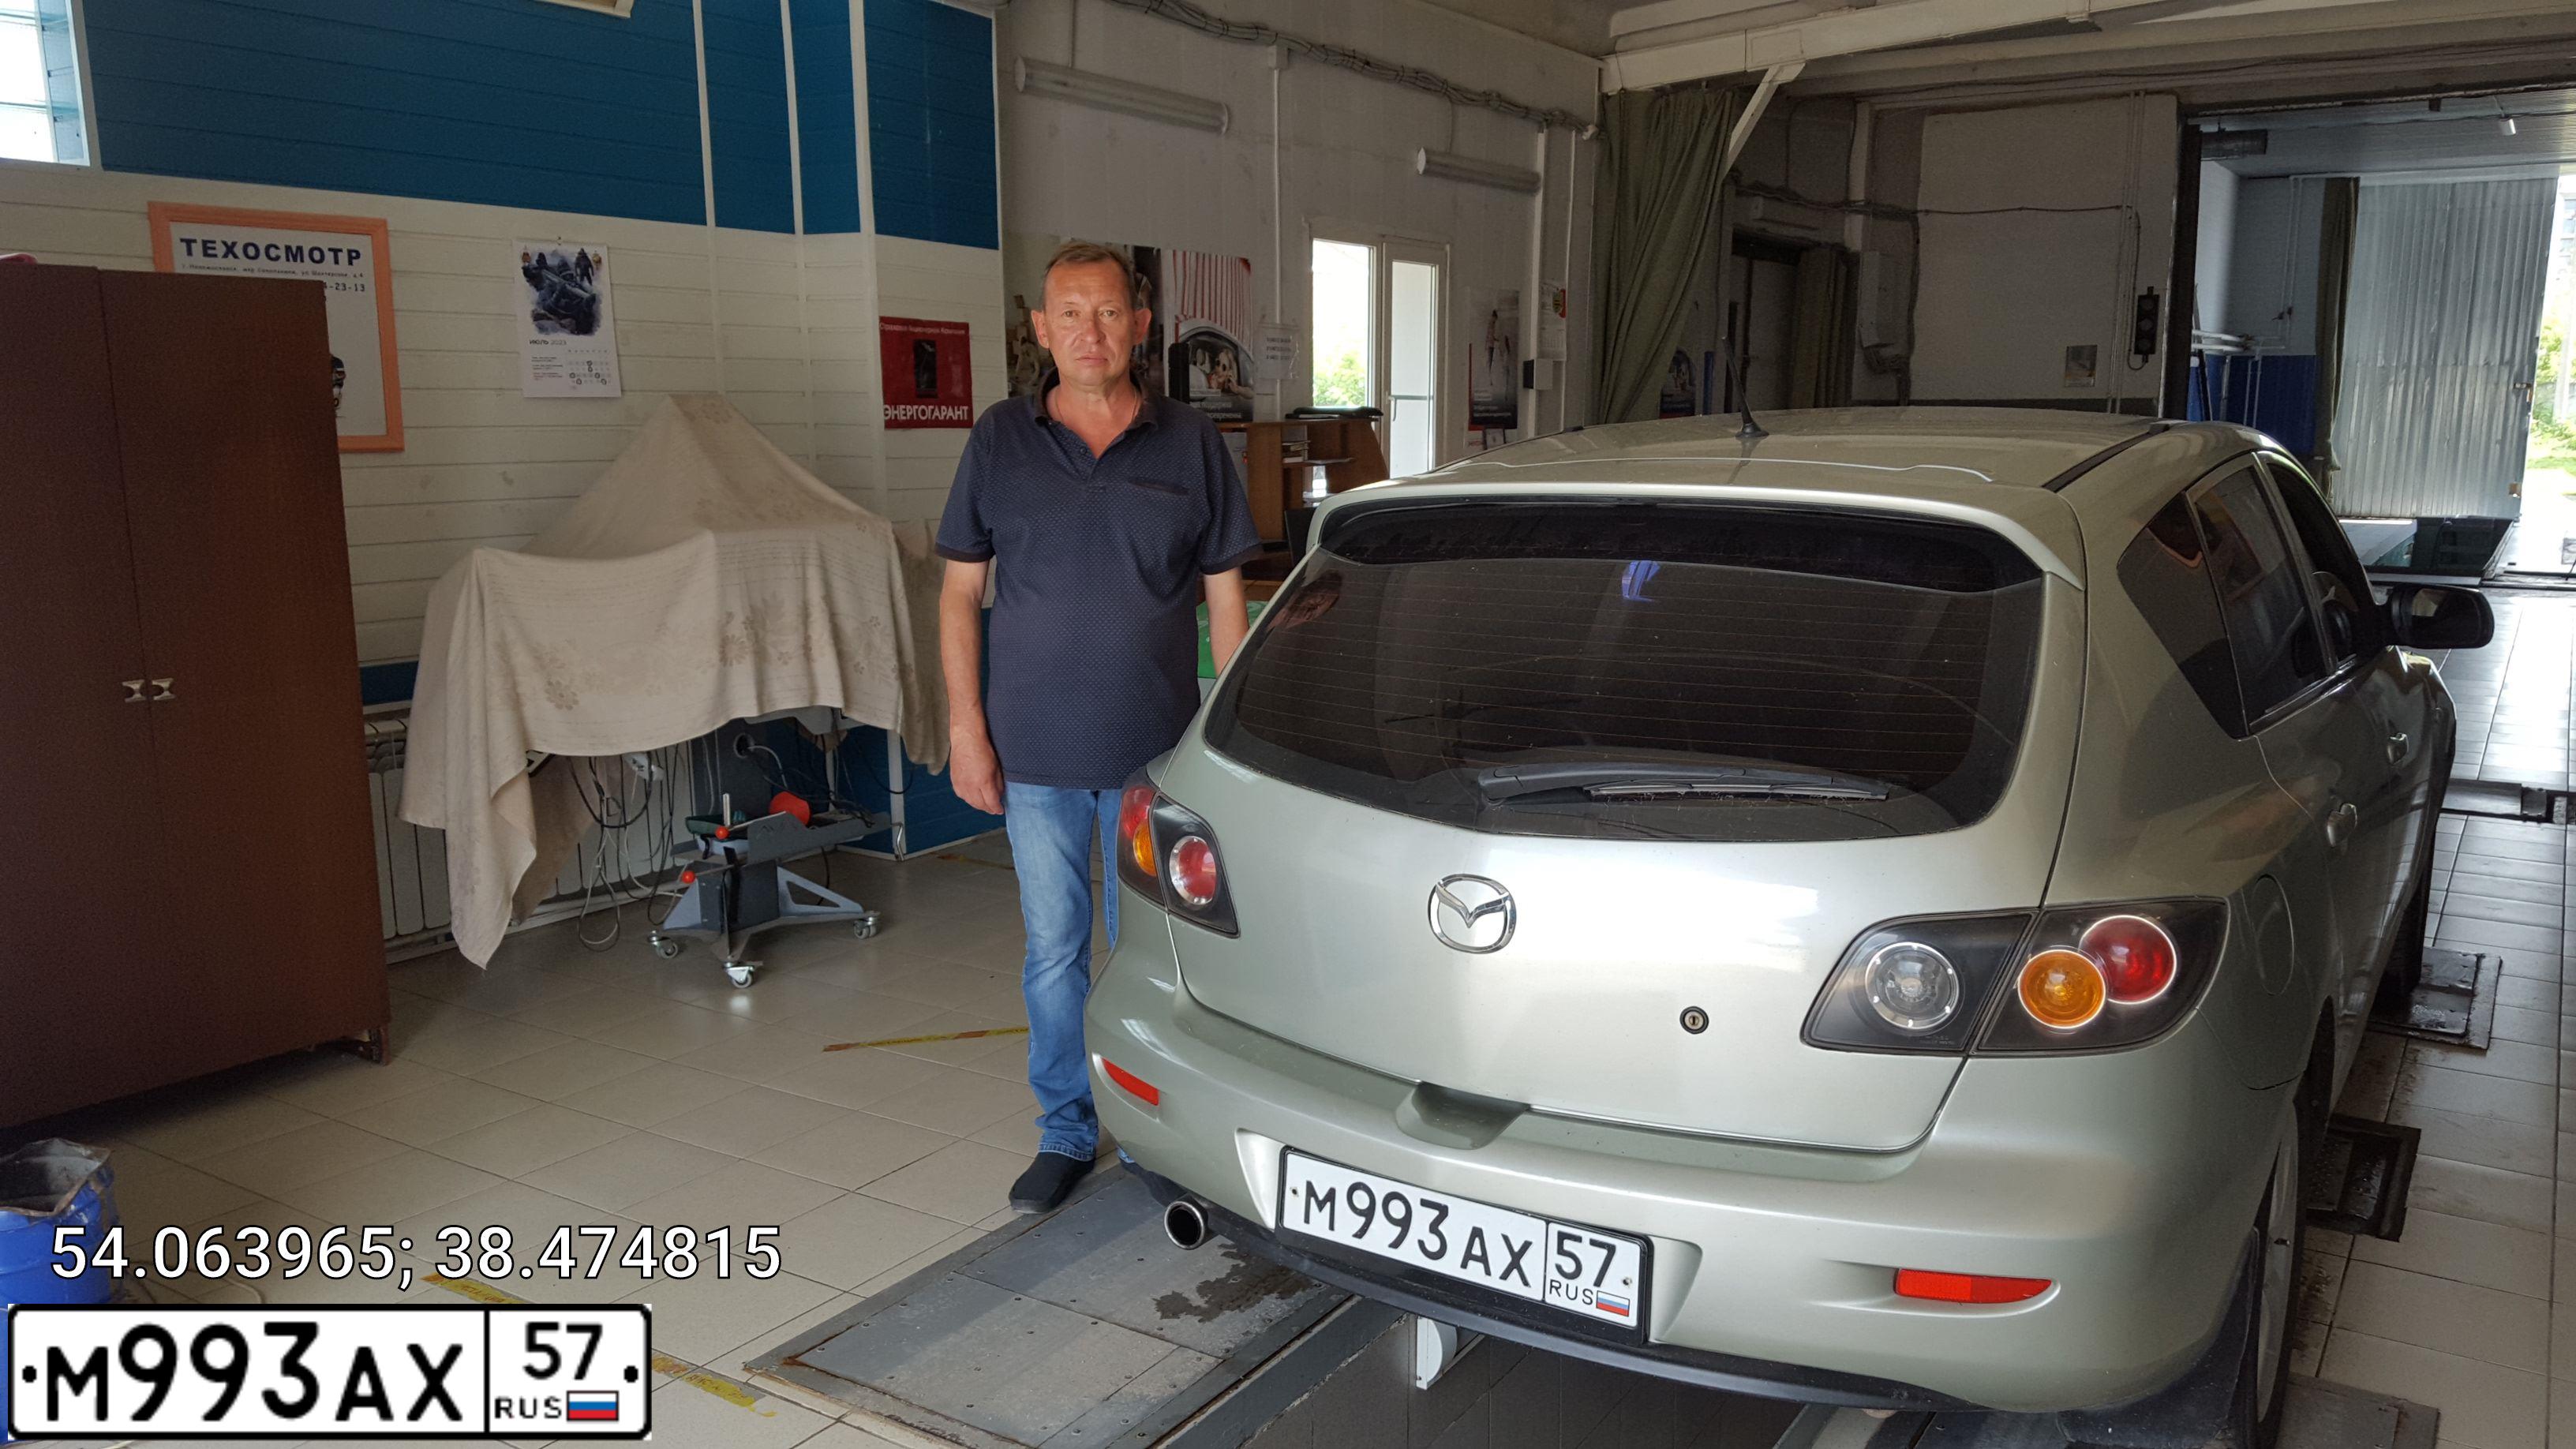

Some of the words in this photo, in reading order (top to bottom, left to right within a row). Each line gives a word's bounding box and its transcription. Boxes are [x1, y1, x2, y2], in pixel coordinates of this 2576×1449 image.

[179, 238, 361, 266] ТЕХОСМОТР
[883, 404, 969, 421] ЭНЕРГОГАРАНТ
[1304, 1180, 1533, 1288] М993АХ
[1555, 1230, 1616, 1288] 57
[1549, 1279, 1594, 1306] RUS
